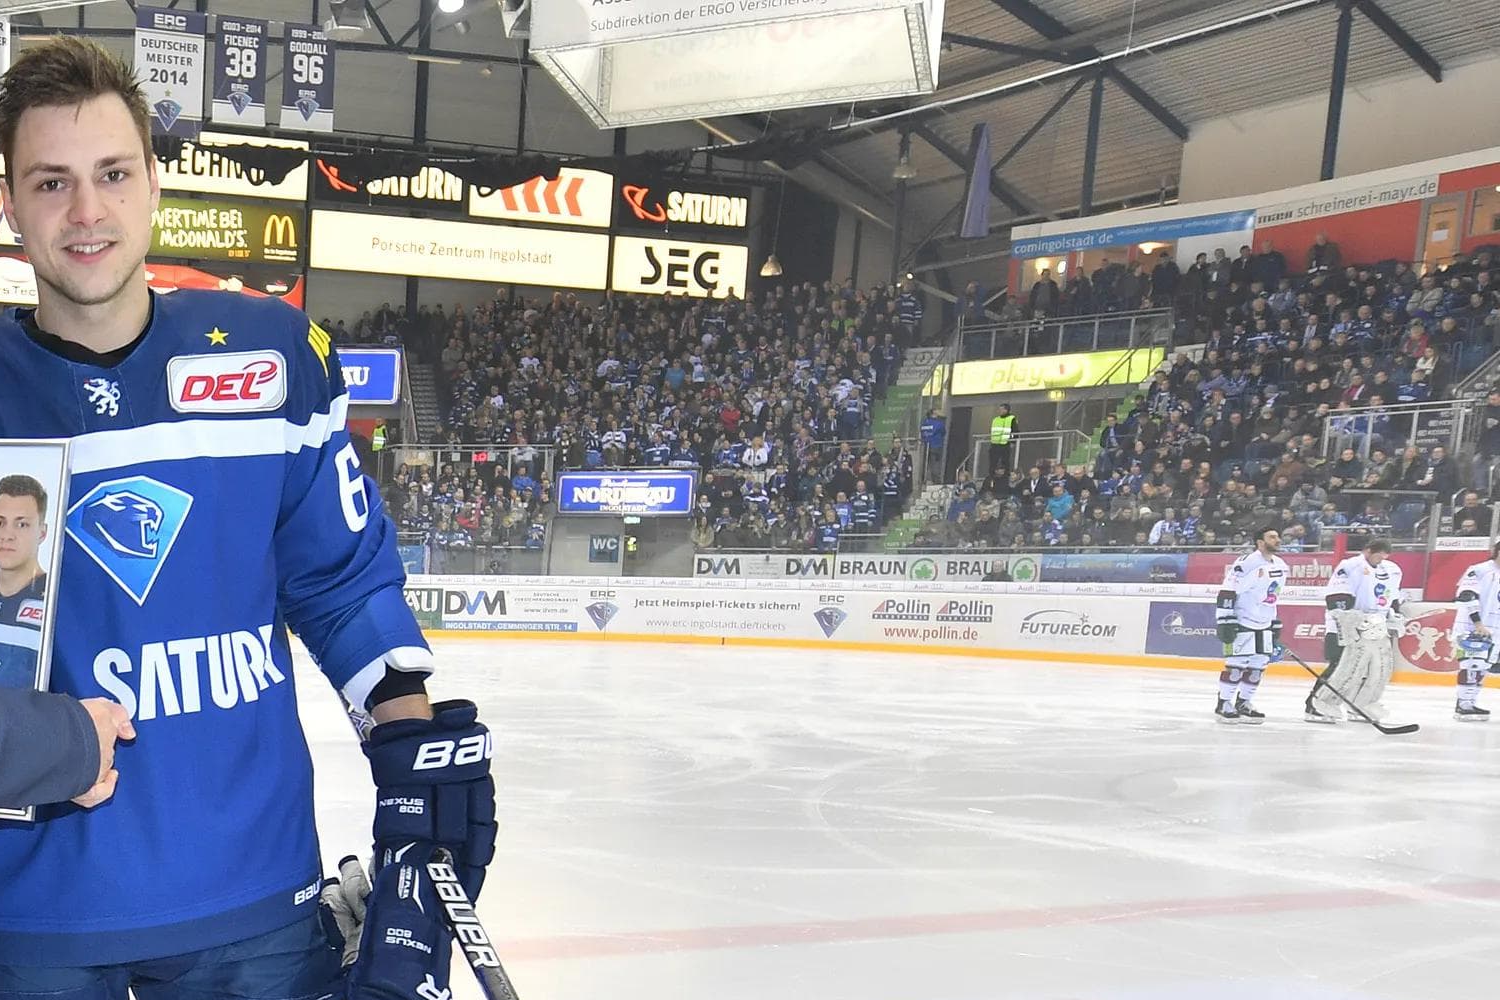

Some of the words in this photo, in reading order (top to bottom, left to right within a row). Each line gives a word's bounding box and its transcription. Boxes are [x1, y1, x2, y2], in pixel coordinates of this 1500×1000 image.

[154, 13, 187, 27] ERC
[591, 11, 671, 32] Subdirektion
[674, 9, 695, 20] der
[699, 3, 735, 17] ERGO
[141, 38, 198, 54] DEUTSCHER
[146, 53, 193, 67] MEISTER
[225, 47, 257, 79] 38
[150, 68, 188, 86] 2014
[292, 54, 324, 85] 96
[1297, 178, 1437, 218] schreinerei-mayr.de
[667, 190, 748, 228] SATURN
[219, 208, 243, 229] BEI
[371, 237, 425, 255] Porsche
[430, 243, 485, 260] Zentrum
[489, 247, 553, 266] Ingolstadt
[181, 360, 278, 403] DEL
[592, 538, 618, 551] WC
[696, 557, 741, 576] DVM
[785, 558, 829, 576] DVM
[839, 560, 906, 575] BRAUN
[444, 590, 507, 615] DVM
[590, 590, 616, 598] ERC
[819, 594, 845, 603] ERC
[634, 598, 660, 609] Jetzt
[662, 599, 757, 612] Heimspiel-Tickets
[759, 601, 801, 612] sichern!
[885, 600, 931, 615] Pollin
[949, 600, 993, 616] Pollin
[445, 622, 492, 631] INGOLSTADT
[884, 625, 979, 642] www.pollin.de
[1020, 622, 1118, 637] FUTURECOM
[412, 731, 494, 771] BAU
[379, 797, 425, 807] NEXUS
[426, 862, 501, 969] BAUER
[384, 935, 432, 955] NEXUS
